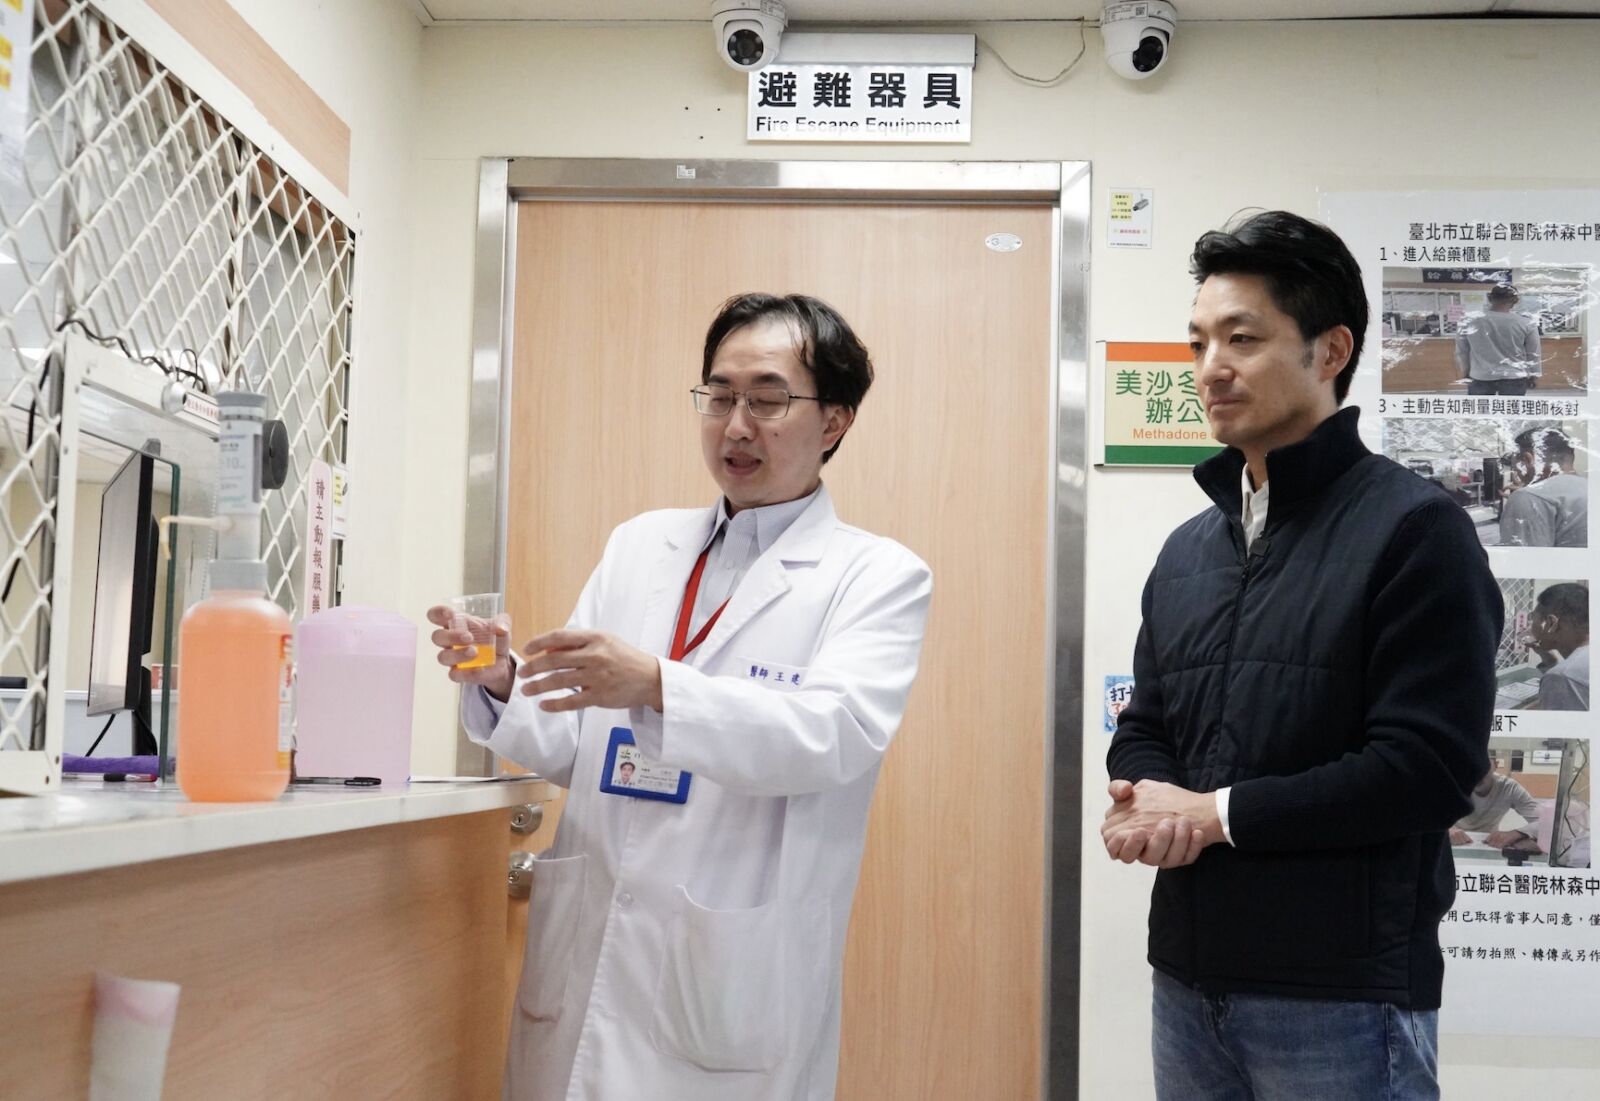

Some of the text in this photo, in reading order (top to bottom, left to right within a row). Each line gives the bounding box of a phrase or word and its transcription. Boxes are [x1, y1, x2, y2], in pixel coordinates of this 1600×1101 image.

[757, 71, 961, 109] 避難器具
[756, 117, 961, 137] Fire Escape Equipment
[1115, 369, 1199, 396] 美沙冬
[1146, 397, 1204, 424] 辦公
[1133, 428, 1207, 440] Methadone
[1440, 910, 1600, 927] 用已取得當事人同意，僅
